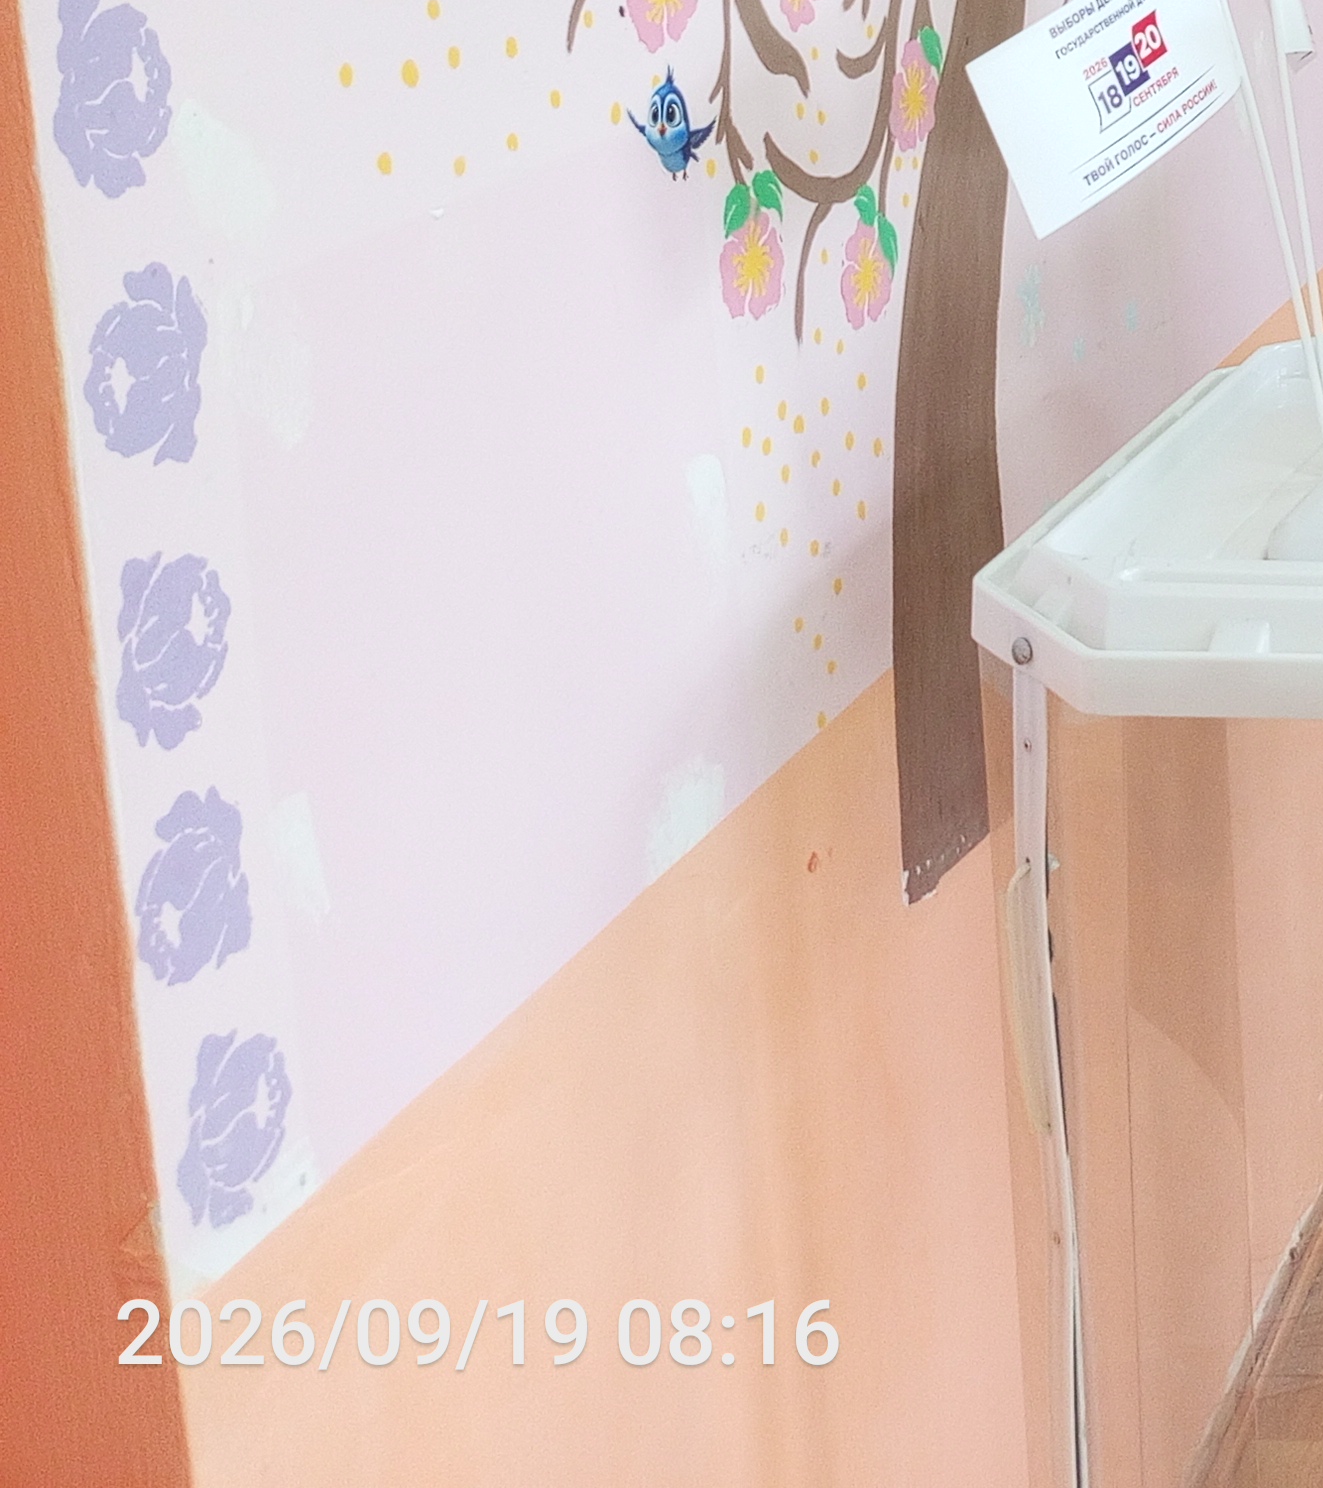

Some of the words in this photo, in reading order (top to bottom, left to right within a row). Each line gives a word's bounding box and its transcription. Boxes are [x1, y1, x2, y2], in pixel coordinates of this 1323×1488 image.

[1049, 1, 1095, 39] ВЫБОРЫ
[1083, 57, 1108, 80] 2026
[1098, 84, 1123, 114] 18
[1115, 54, 1141, 86] 19
[1134, 24, 1162, 59] 20
[1132, 66, 1179, 106] СЕНТЯБРЯ
[1083, 157, 1115, 186] ТВОЙ
[1114, 134, 1149, 166] ГОЛОС
[1156, 109, 1183, 133] СИЛА
[1181, 79, 1218, 115] РОССИИ!
